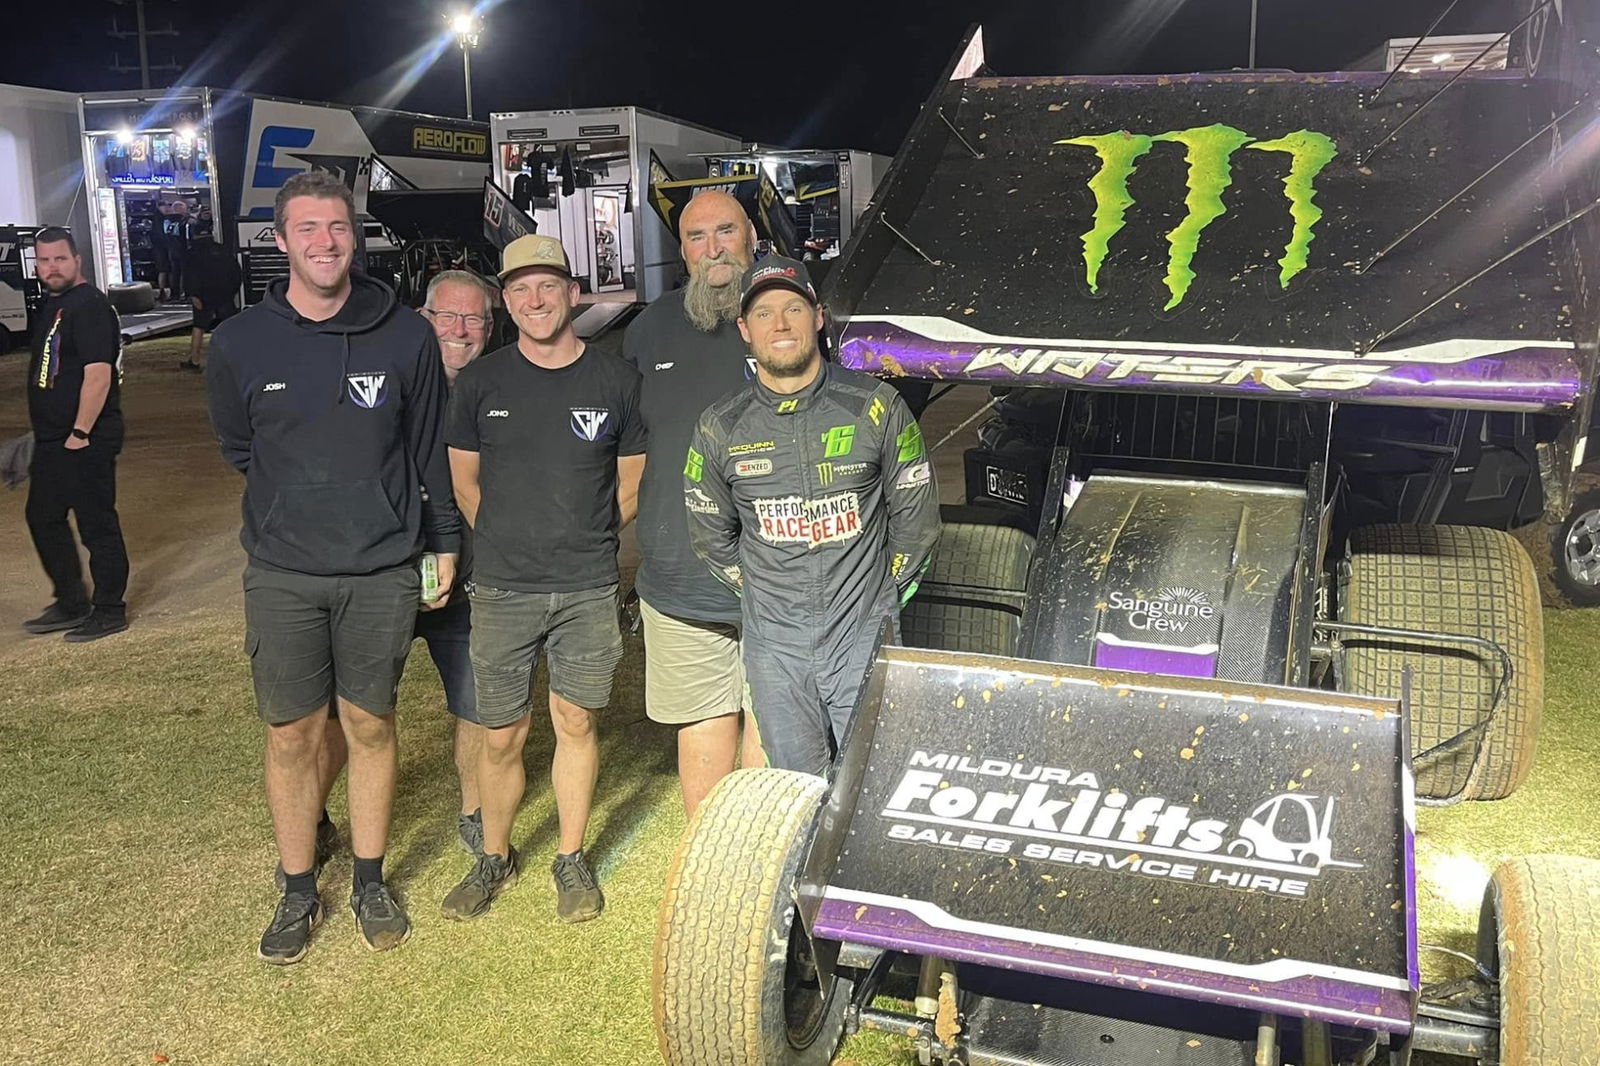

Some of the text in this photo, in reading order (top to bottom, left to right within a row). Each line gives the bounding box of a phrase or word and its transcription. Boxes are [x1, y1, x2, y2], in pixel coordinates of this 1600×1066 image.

[414, 127, 487, 155] AEROFLOW
[963, 347, 1392, 392] WATERS
[263, 382, 286, 392] JOSH
[821, 424, 856, 458] 16
[833, 462, 868, 473] MONSTER
[759, 495, 855, 523] PERFORMANCE
[1108, 591, 1213, 618] Sanguine
[1128, 610, 1189, 633] Crew
[910, 750, 1099, 790] MILDURA
[885, 769, 1229, 853] Forklifts
[887, 824, 1309, 897] SALES SERVICE HIRE
